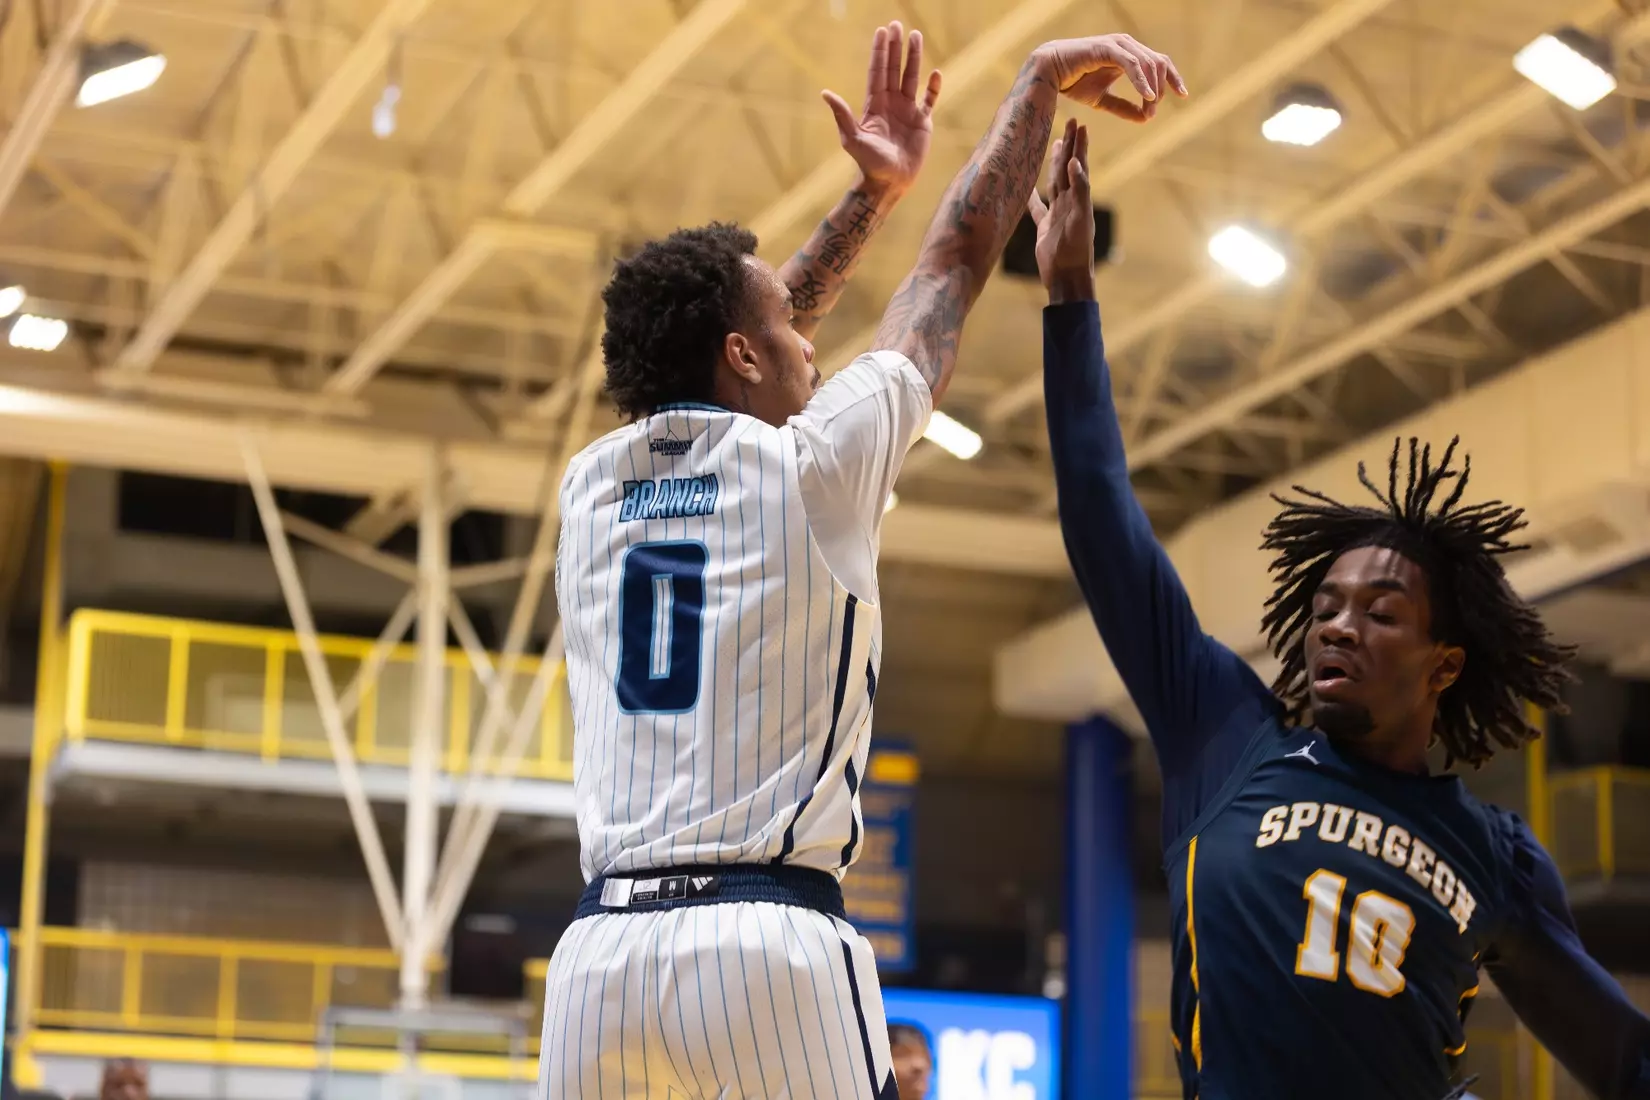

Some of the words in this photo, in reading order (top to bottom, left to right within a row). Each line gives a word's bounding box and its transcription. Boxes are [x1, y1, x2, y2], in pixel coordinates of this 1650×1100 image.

[619, 473, 719, 522] BRANCH
[615, 538, 710, 715] 0
[1255, 802, 1477, 935] SPURGEON
[1295, 868, 1416, 998] 10
